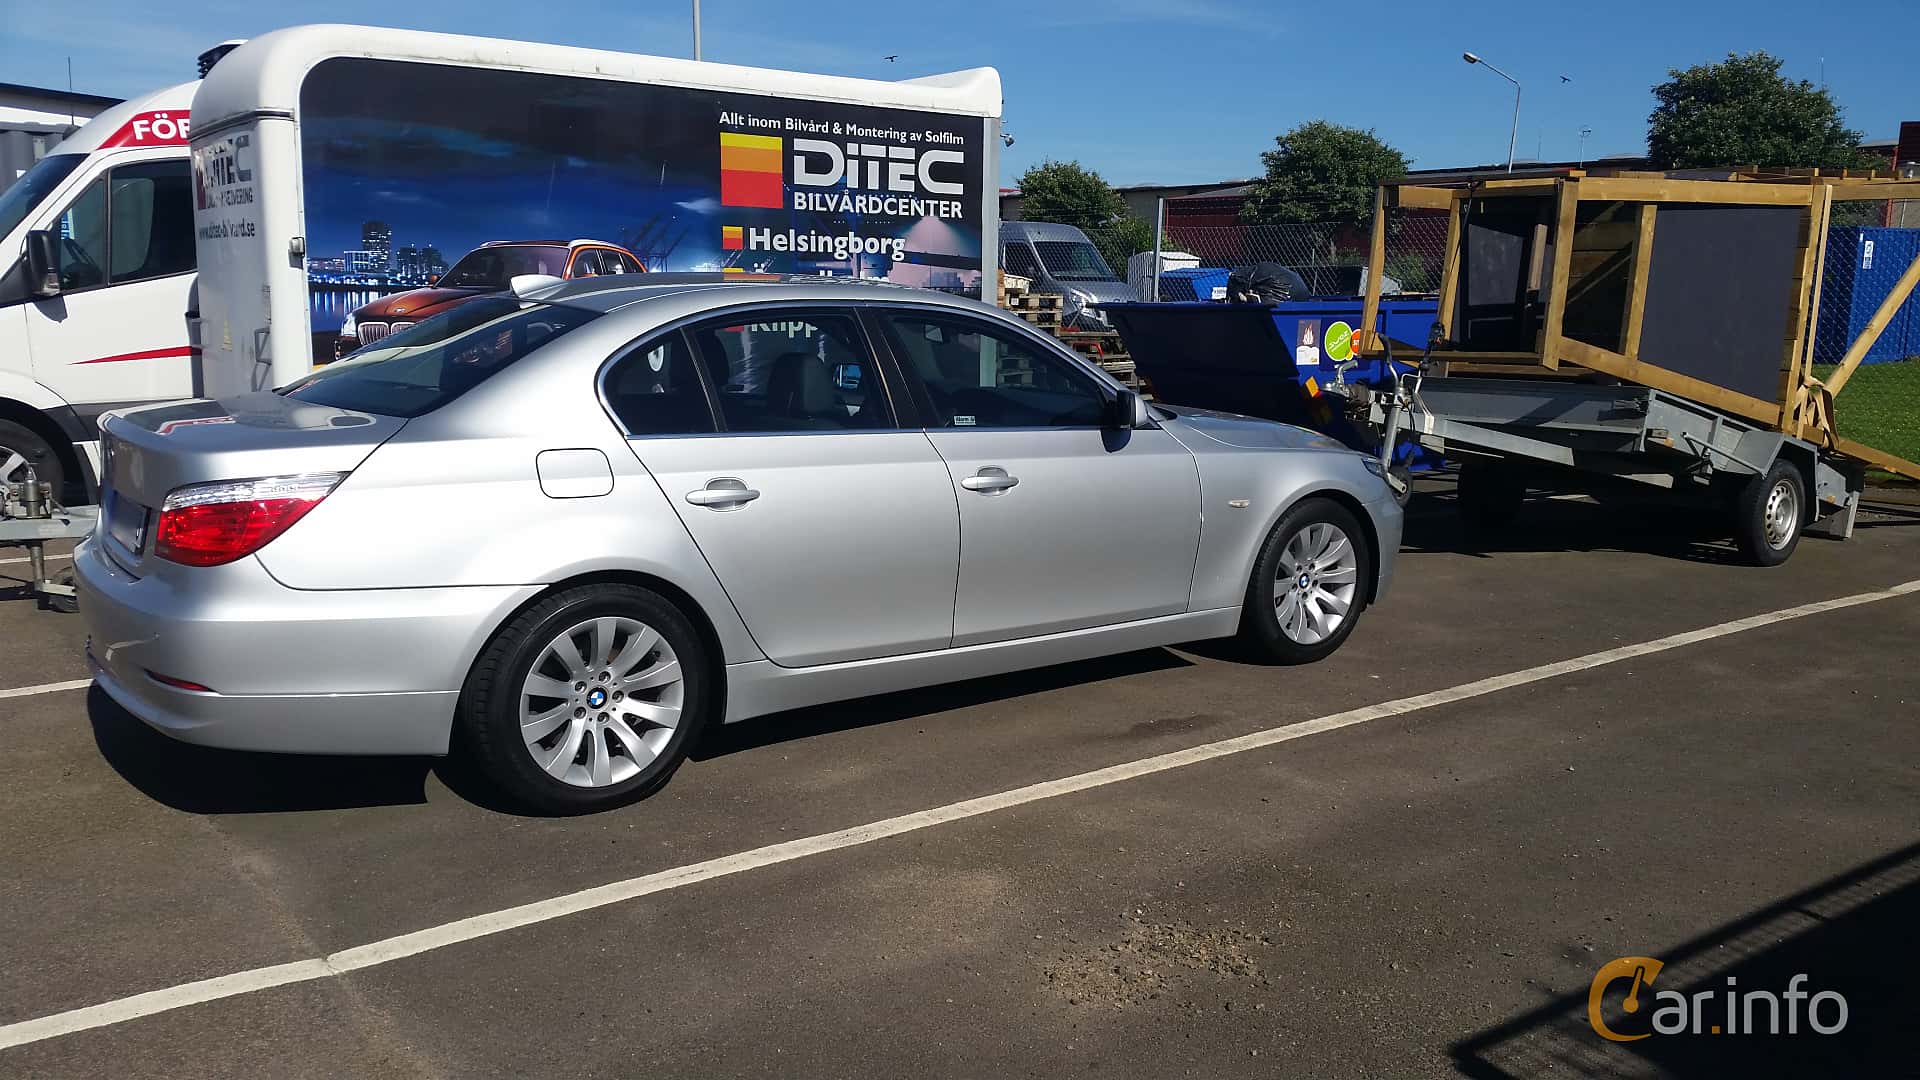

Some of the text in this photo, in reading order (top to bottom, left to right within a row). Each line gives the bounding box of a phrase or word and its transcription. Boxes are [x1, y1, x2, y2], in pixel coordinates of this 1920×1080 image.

[719, 111, 964, 145] Allt inom Bilvård & Montering av Solfilm
[794, 189, 963, 218] BILVÅRDCENTER
[749, 227, 905, 260] Helsingborg
